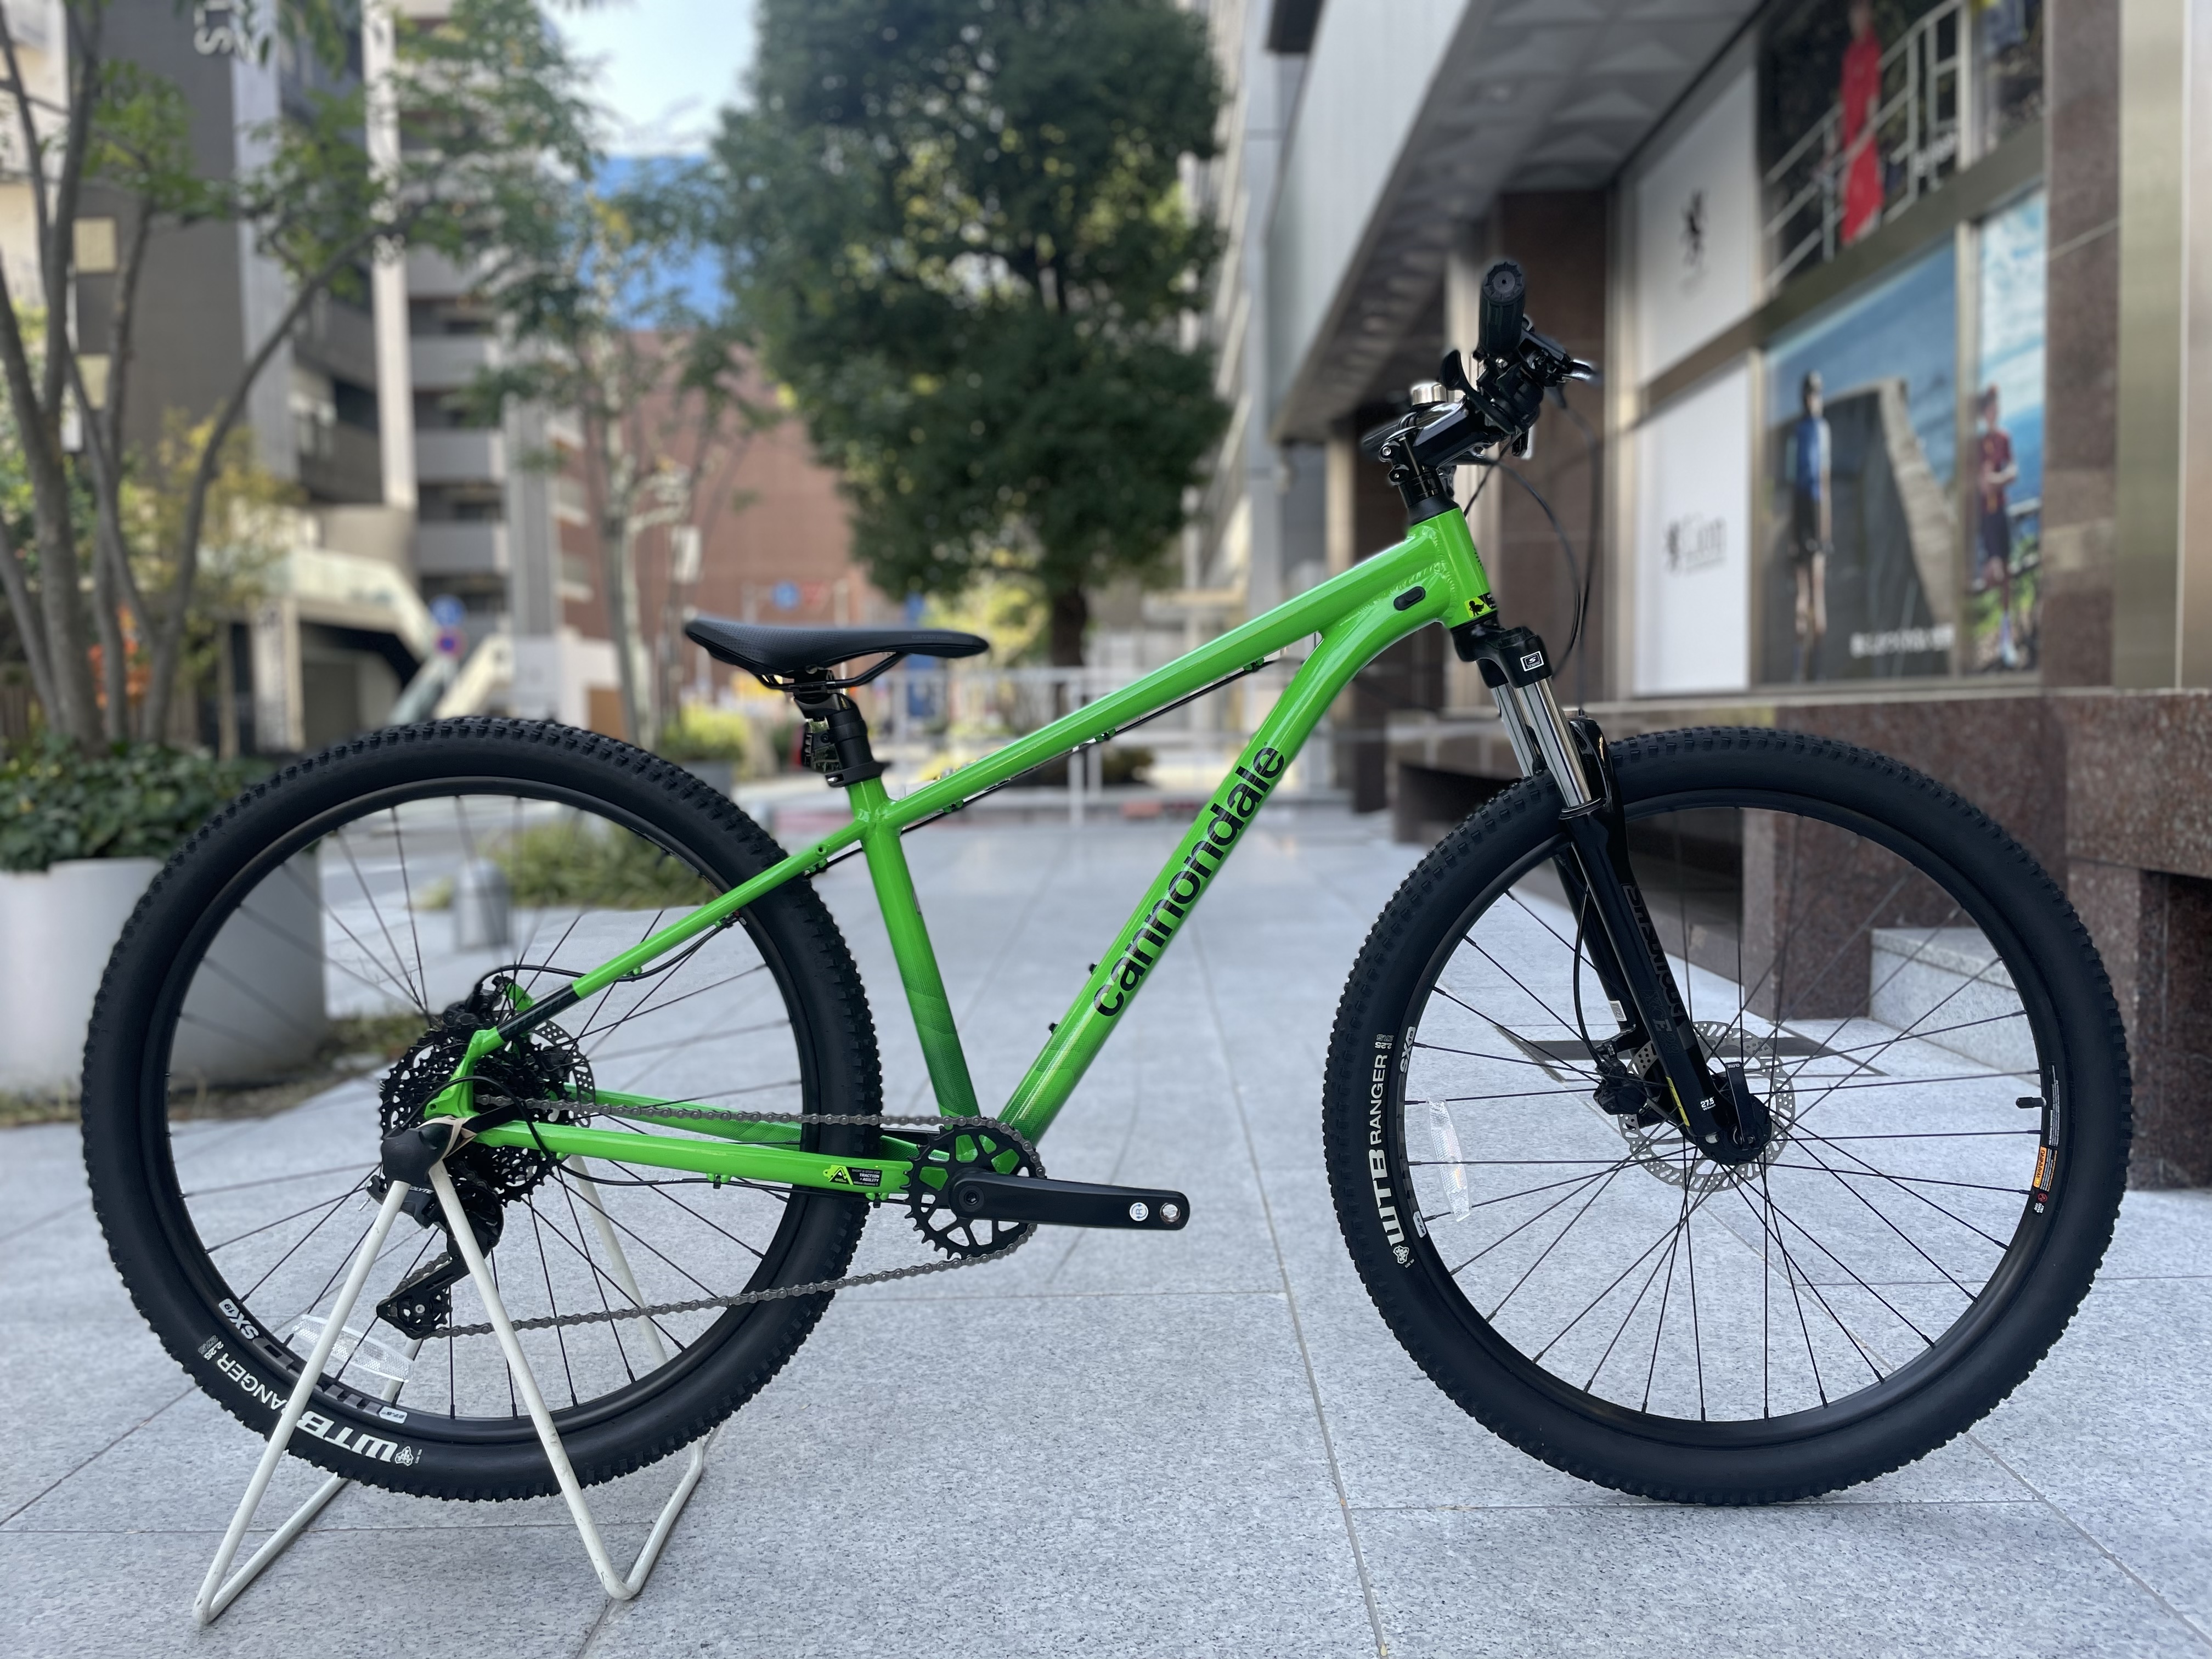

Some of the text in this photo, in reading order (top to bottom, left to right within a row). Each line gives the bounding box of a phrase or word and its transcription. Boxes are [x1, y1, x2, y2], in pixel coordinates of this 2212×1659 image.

[1093, 747, 1284, 1017] cannondale
[1400, 1042, 1413, 1074] SX
[1369, 1054, 1405, 1246] WTB RANGER
[229, 1312, 259, 1339] SX
[217, 1352, 291, 1417] ANGER
[296, 1410, 398, 1463] WTB
